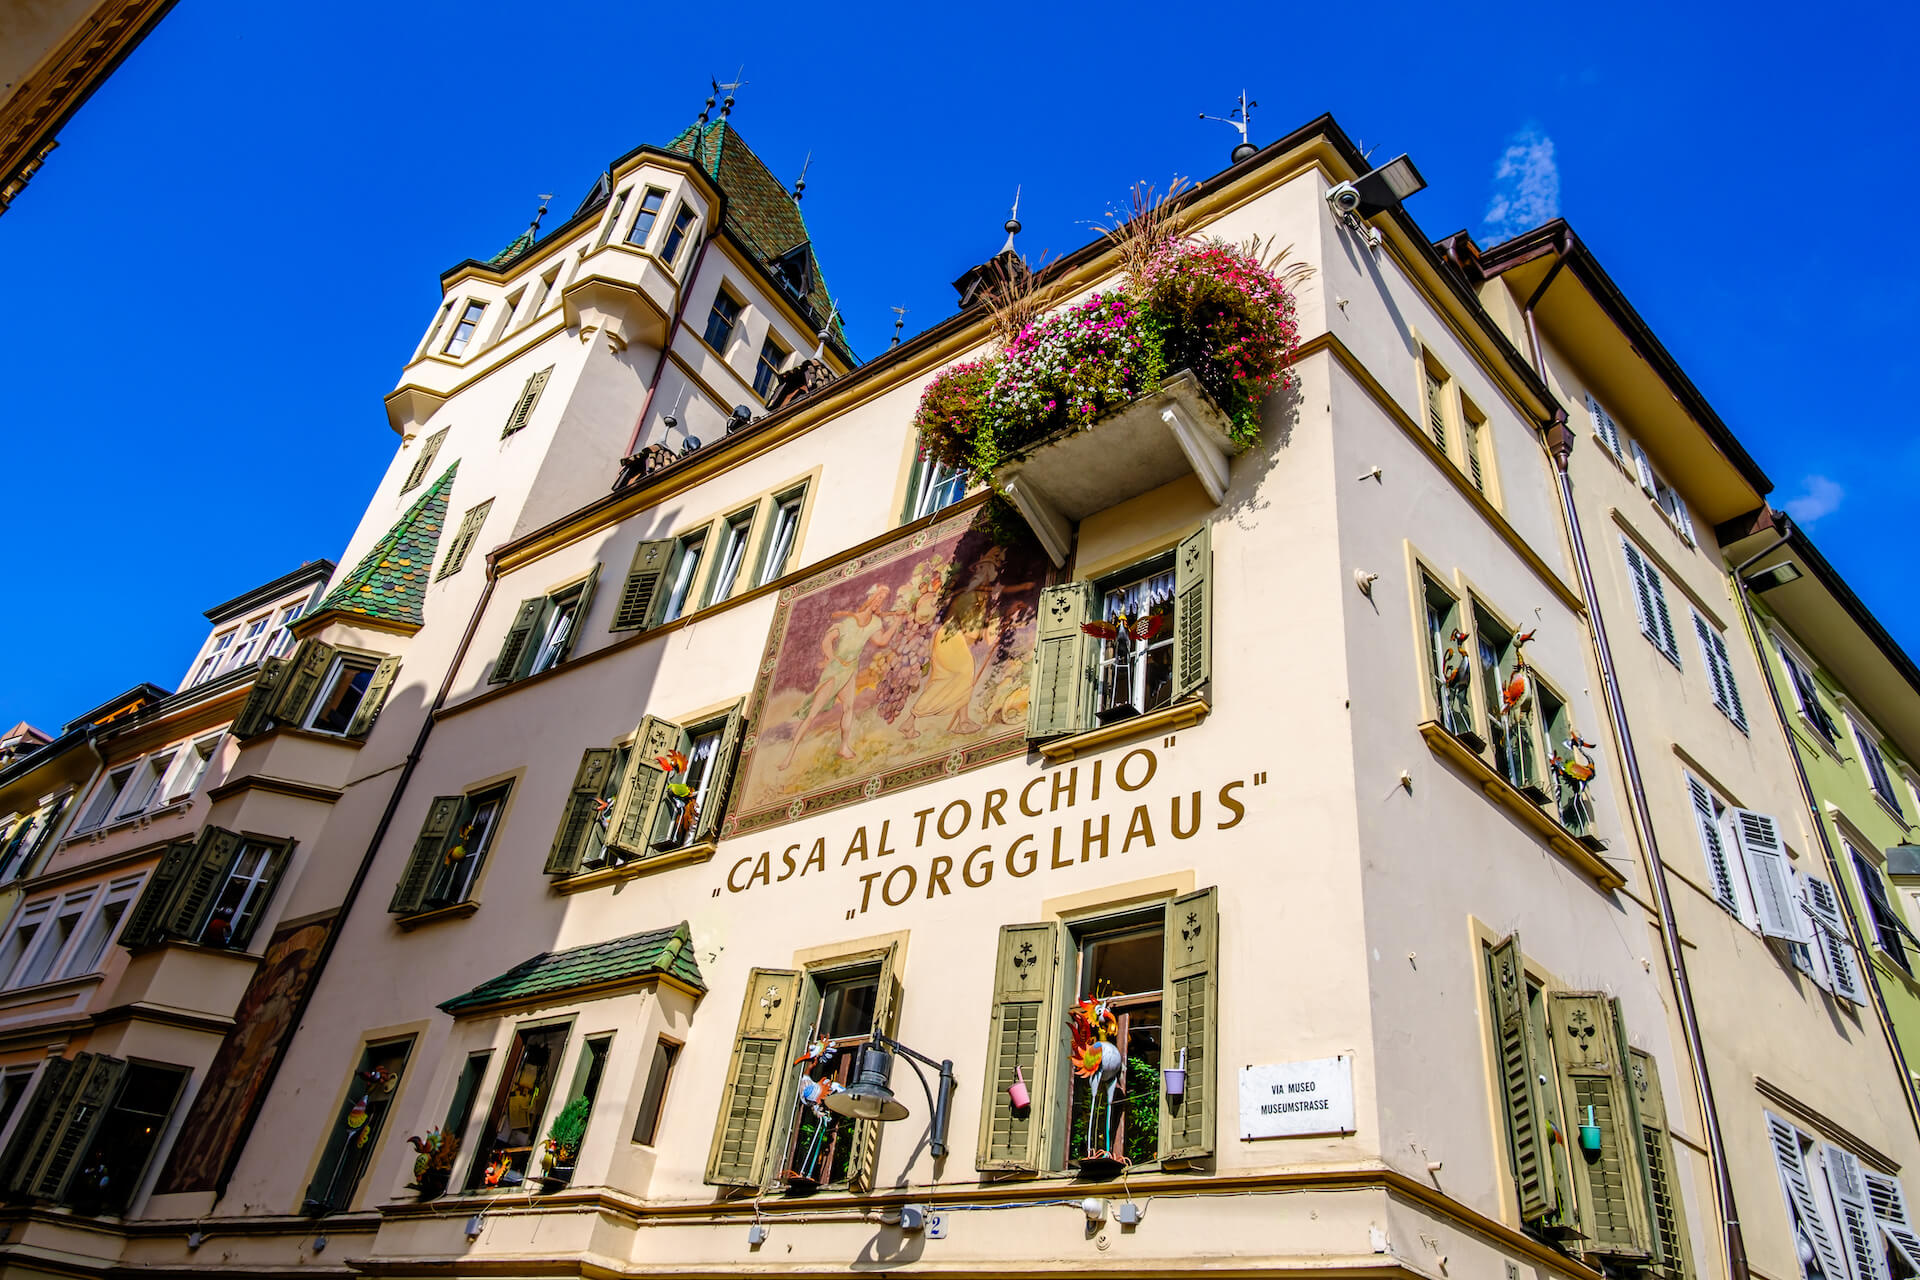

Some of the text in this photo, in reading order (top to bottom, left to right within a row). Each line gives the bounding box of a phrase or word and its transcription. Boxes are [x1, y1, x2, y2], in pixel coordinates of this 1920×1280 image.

[841, 819, 896, 867] AL
[1271, 1081, 1316, 1095] VIA MUSEO
[1260, 1099, 1329, 1115] MUSEUMSTRASSE
[931, 1216, 941, 1235] 2
